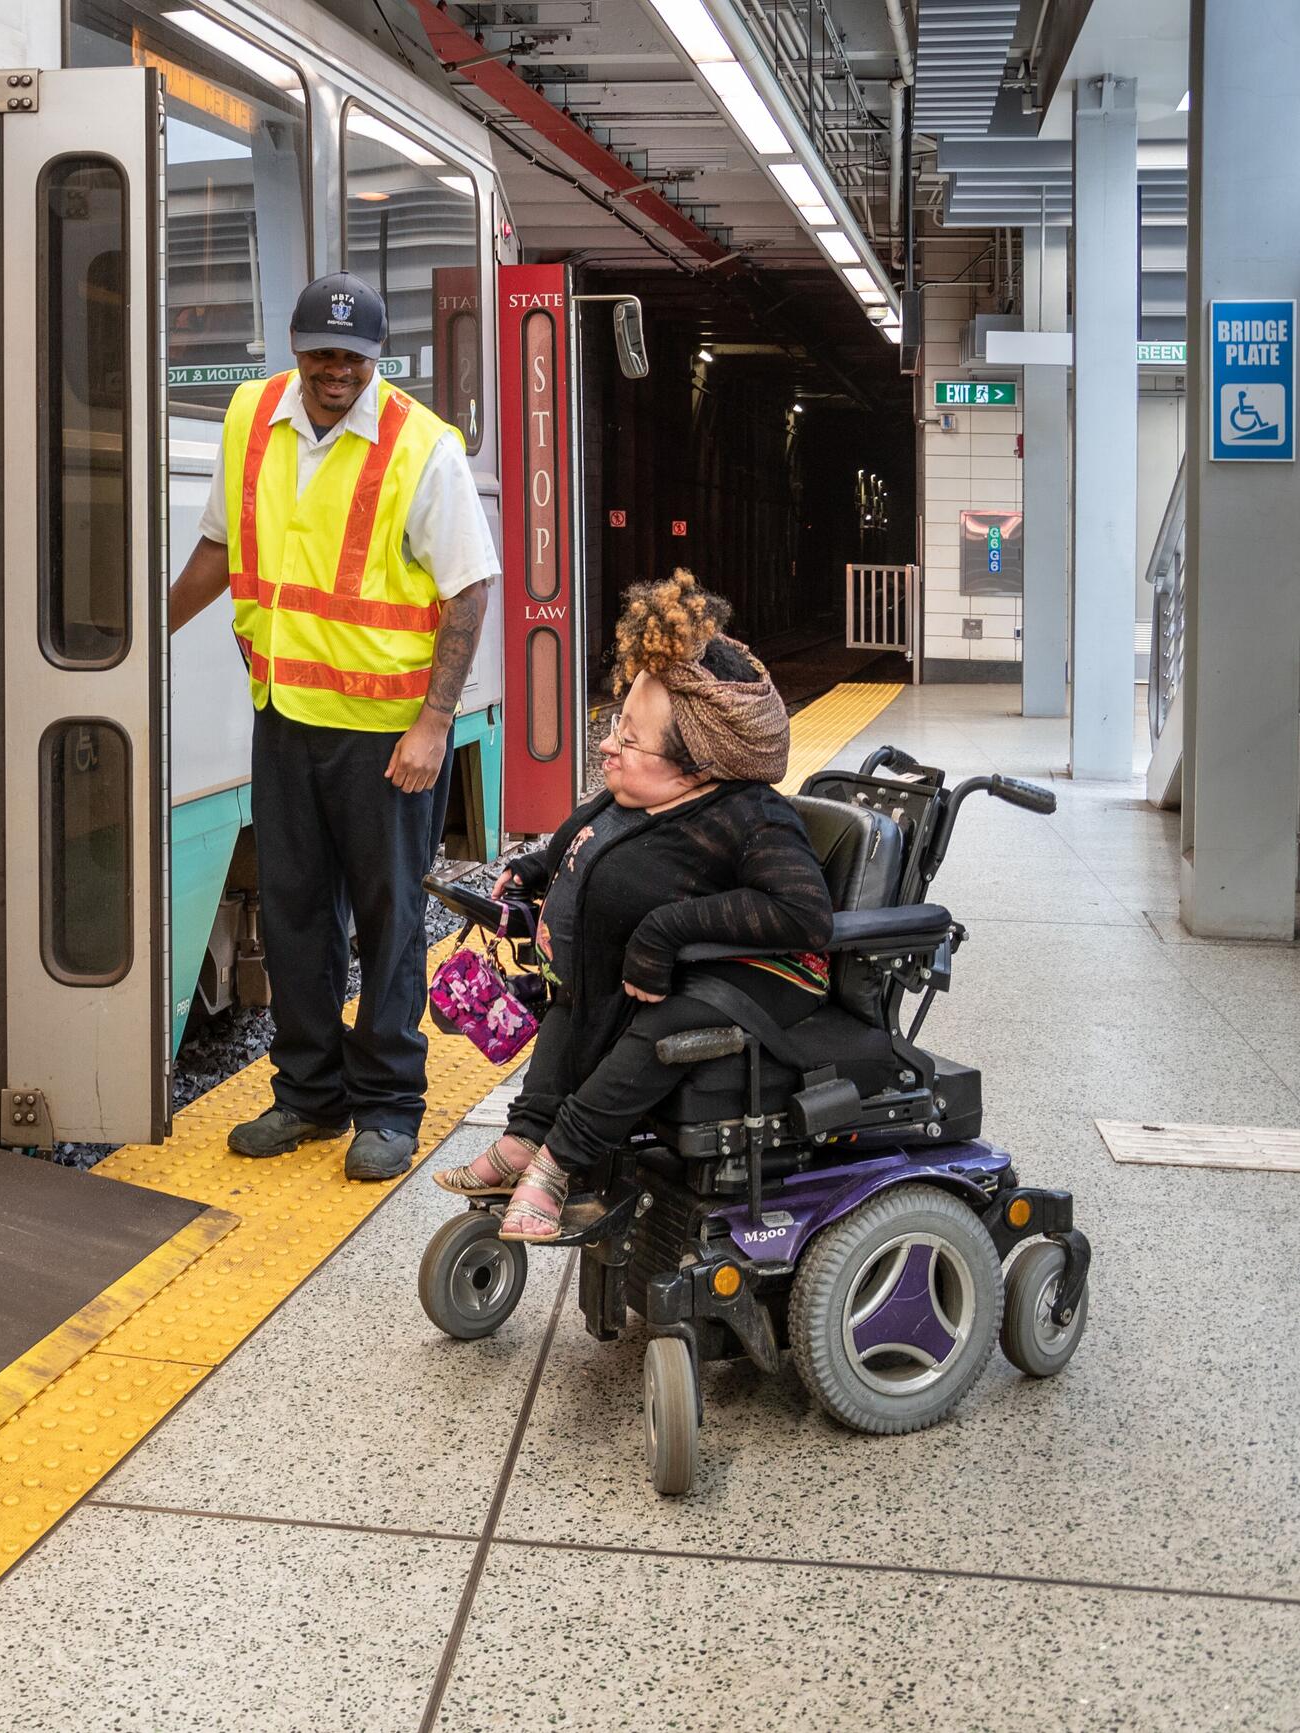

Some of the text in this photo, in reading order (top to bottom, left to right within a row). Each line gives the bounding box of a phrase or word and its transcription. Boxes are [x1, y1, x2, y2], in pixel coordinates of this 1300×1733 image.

[331, 293, 355, 304] MBTA
[509, 293, 563, 307] STATE
[1217, 320, 1288, 342] BRIDGE
[1138, 346, 1184, 360] REEN
[1225, 343, 1280, 366] PLATE
[946, 384, 970, 403] EXIT
[532, 356, 551, 564] STOP
[525, 606, 567, 620] LAW
[743, 1227, 787, 1244] M300
